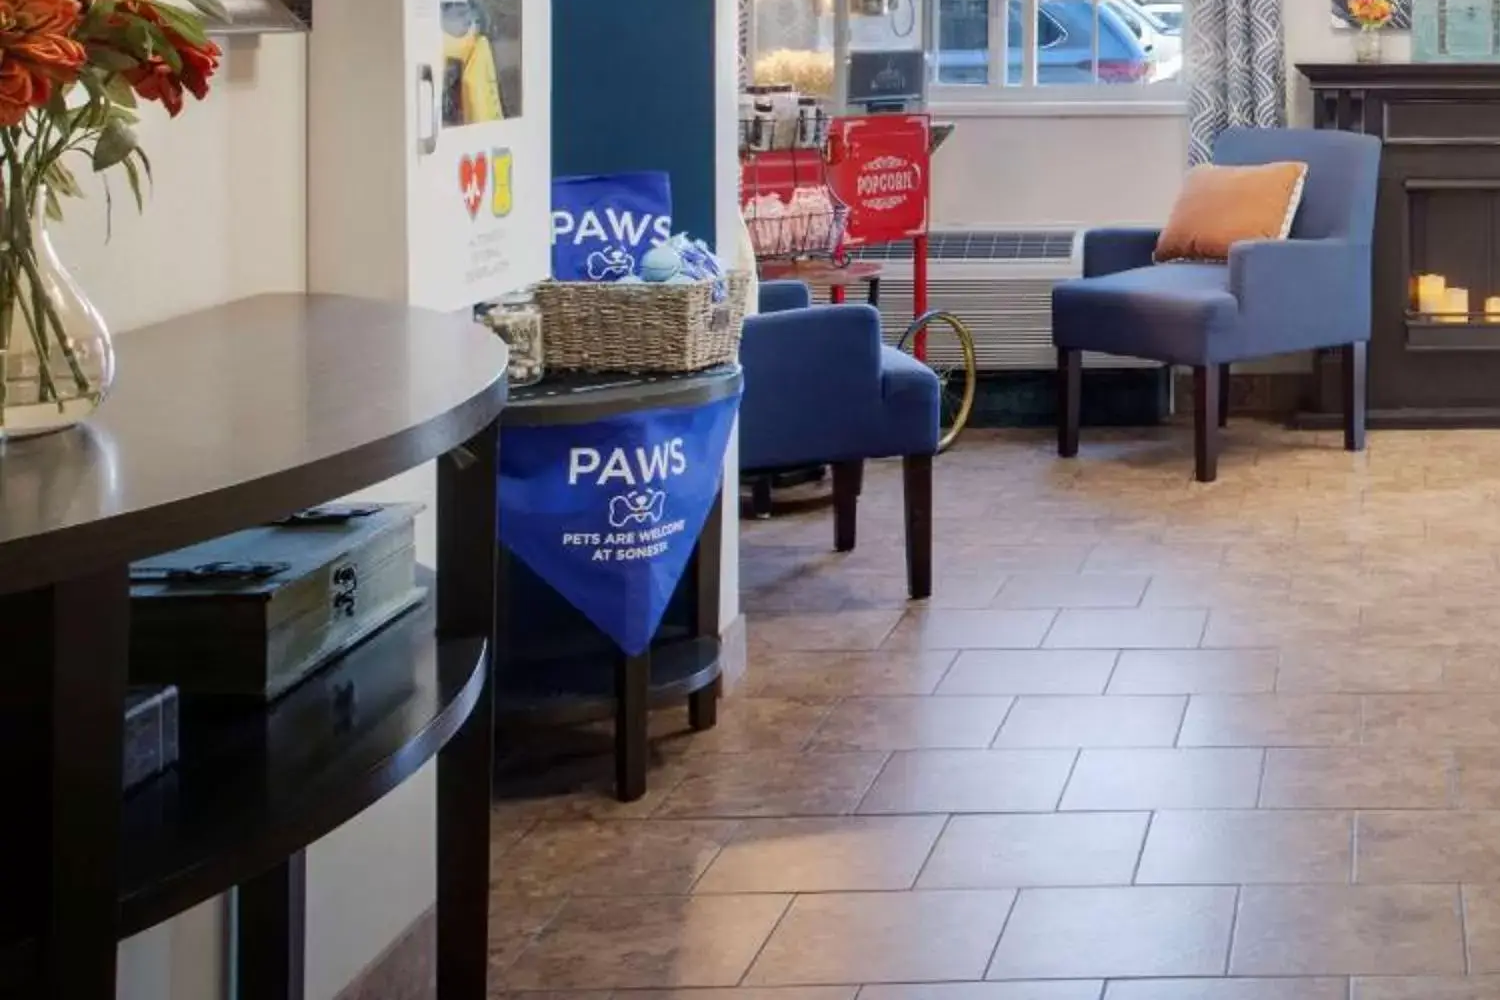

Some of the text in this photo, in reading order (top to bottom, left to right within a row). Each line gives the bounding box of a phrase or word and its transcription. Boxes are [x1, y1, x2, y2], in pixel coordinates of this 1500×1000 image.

[857, 171, 913, 197] POPCORN
[550, 207, 672, 250] PAWS
[568, 437, 686, 486] PAWS
[563, 532, 601, 546] PETS
[603, 532, 635, 545] ARE
[591, 548, 613, 562] AT
